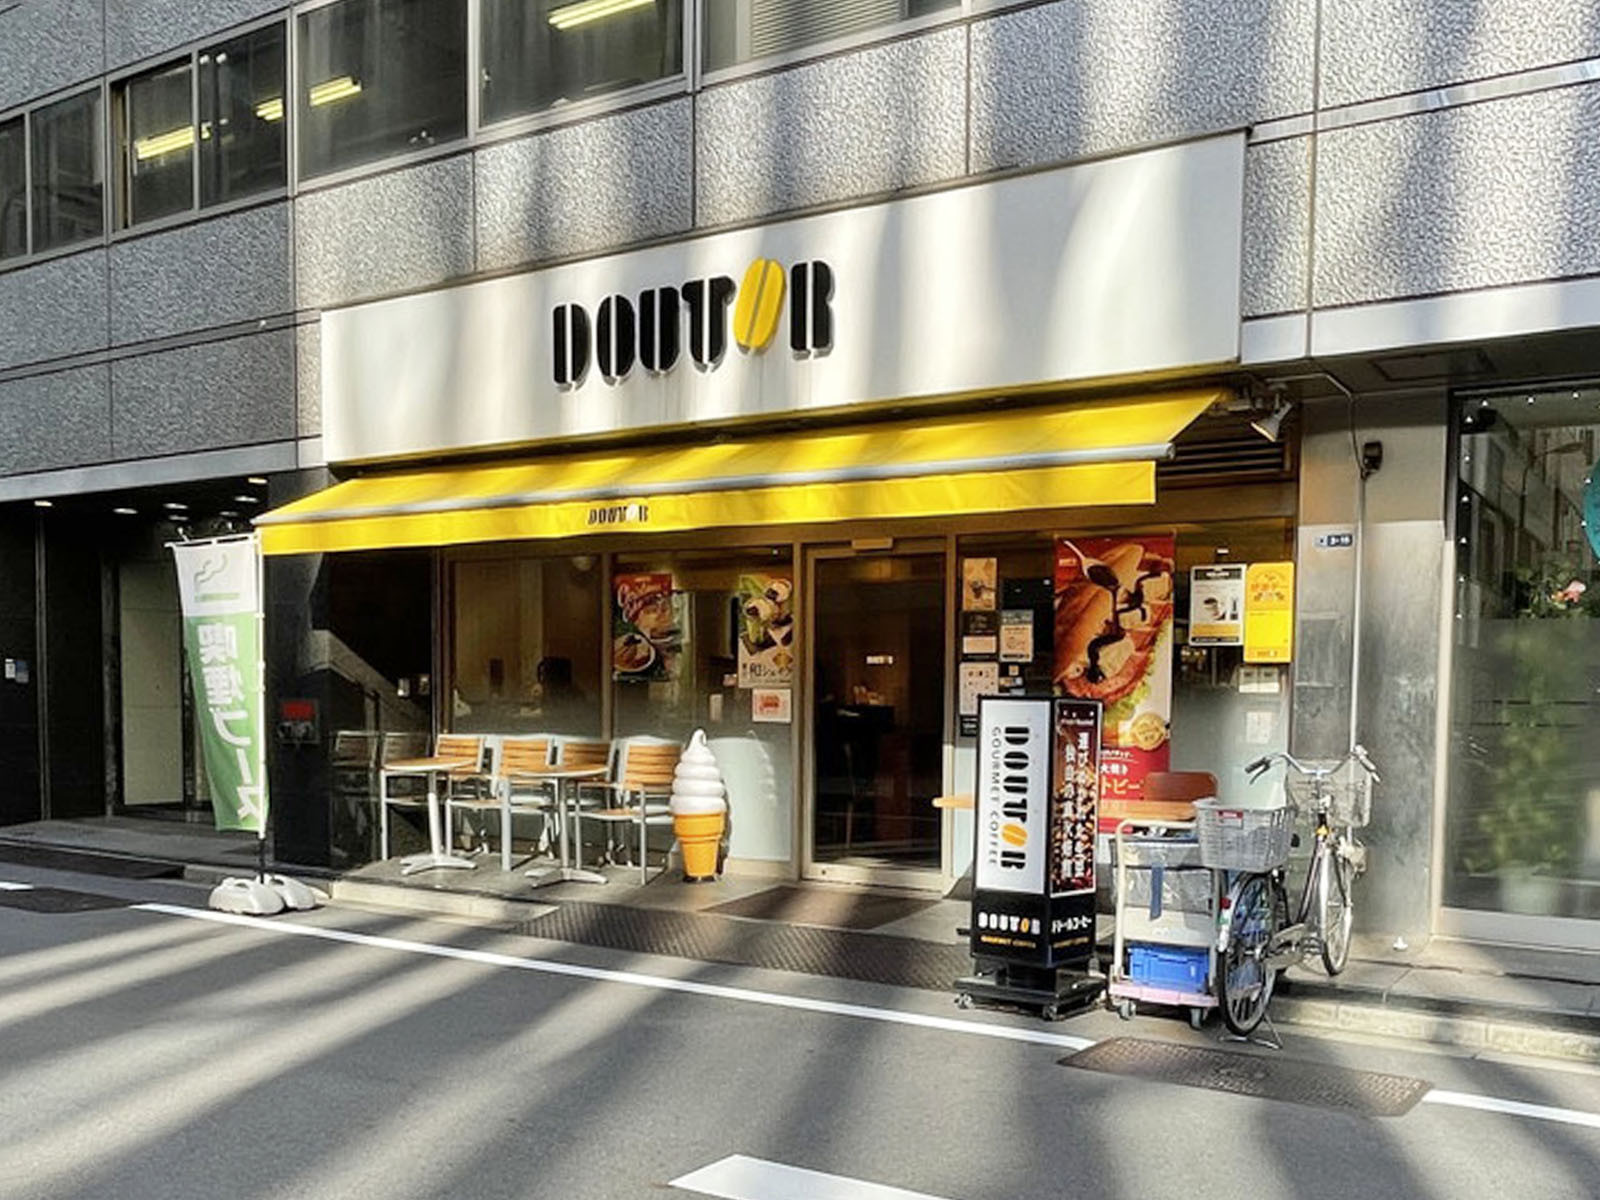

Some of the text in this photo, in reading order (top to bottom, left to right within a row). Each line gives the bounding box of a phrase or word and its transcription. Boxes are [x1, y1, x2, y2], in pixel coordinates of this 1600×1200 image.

[553, 257, 835, 388] DOUTOR
[989, 727, 1001, 864] GOURMET COFFEE
[1001, 726, 1030, 869] DOUTOR
[978, 912, 1040, 934] DOUTOR
